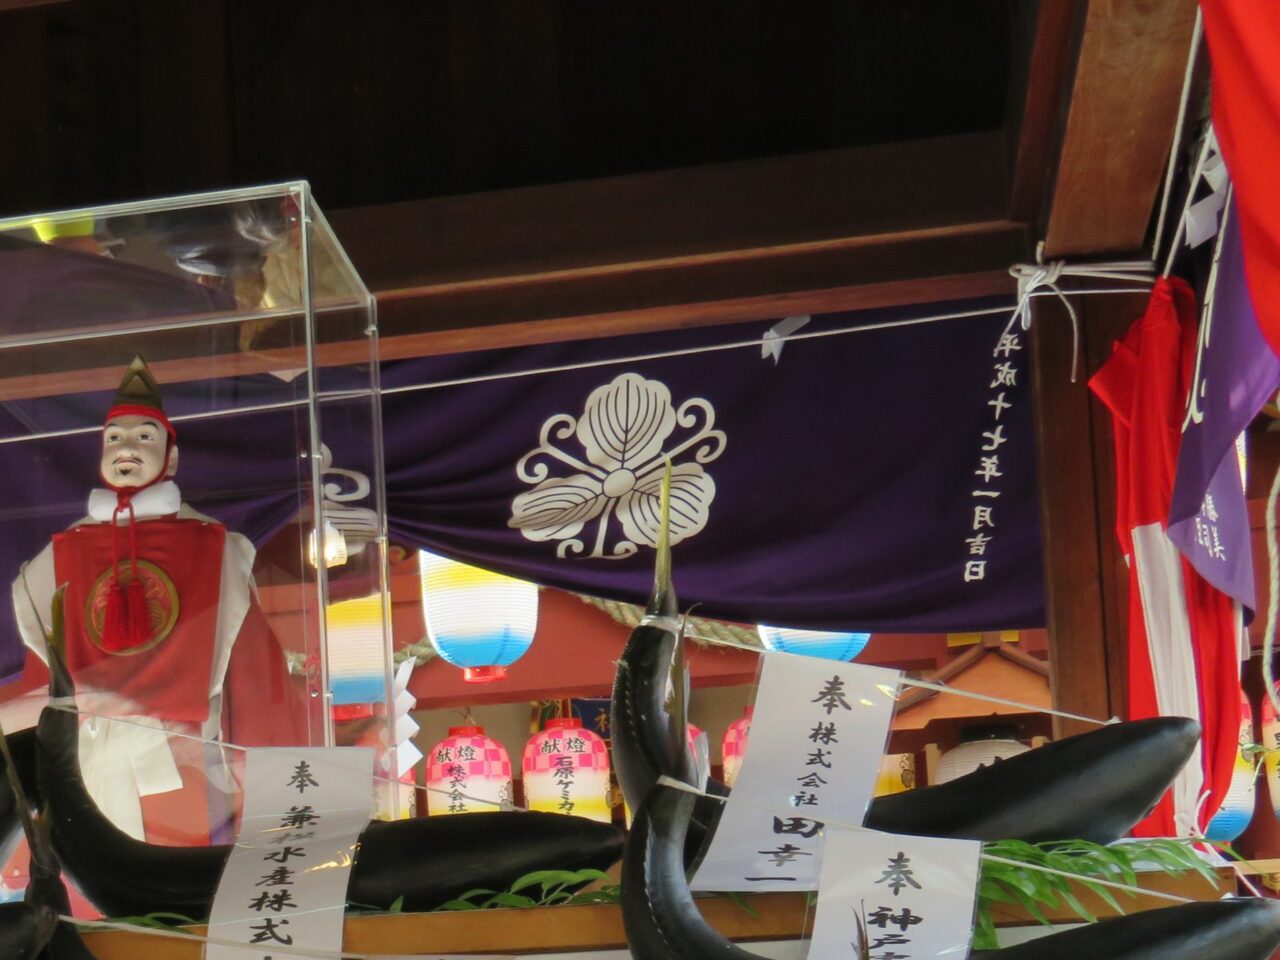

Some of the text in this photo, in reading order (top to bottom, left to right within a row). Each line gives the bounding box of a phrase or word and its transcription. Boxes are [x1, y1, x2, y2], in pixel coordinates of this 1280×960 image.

[435, 745, 477, 763] 献燈
[540, 737, 586, 754] 献燈
[446, 765, 468, 813] 株式会社
